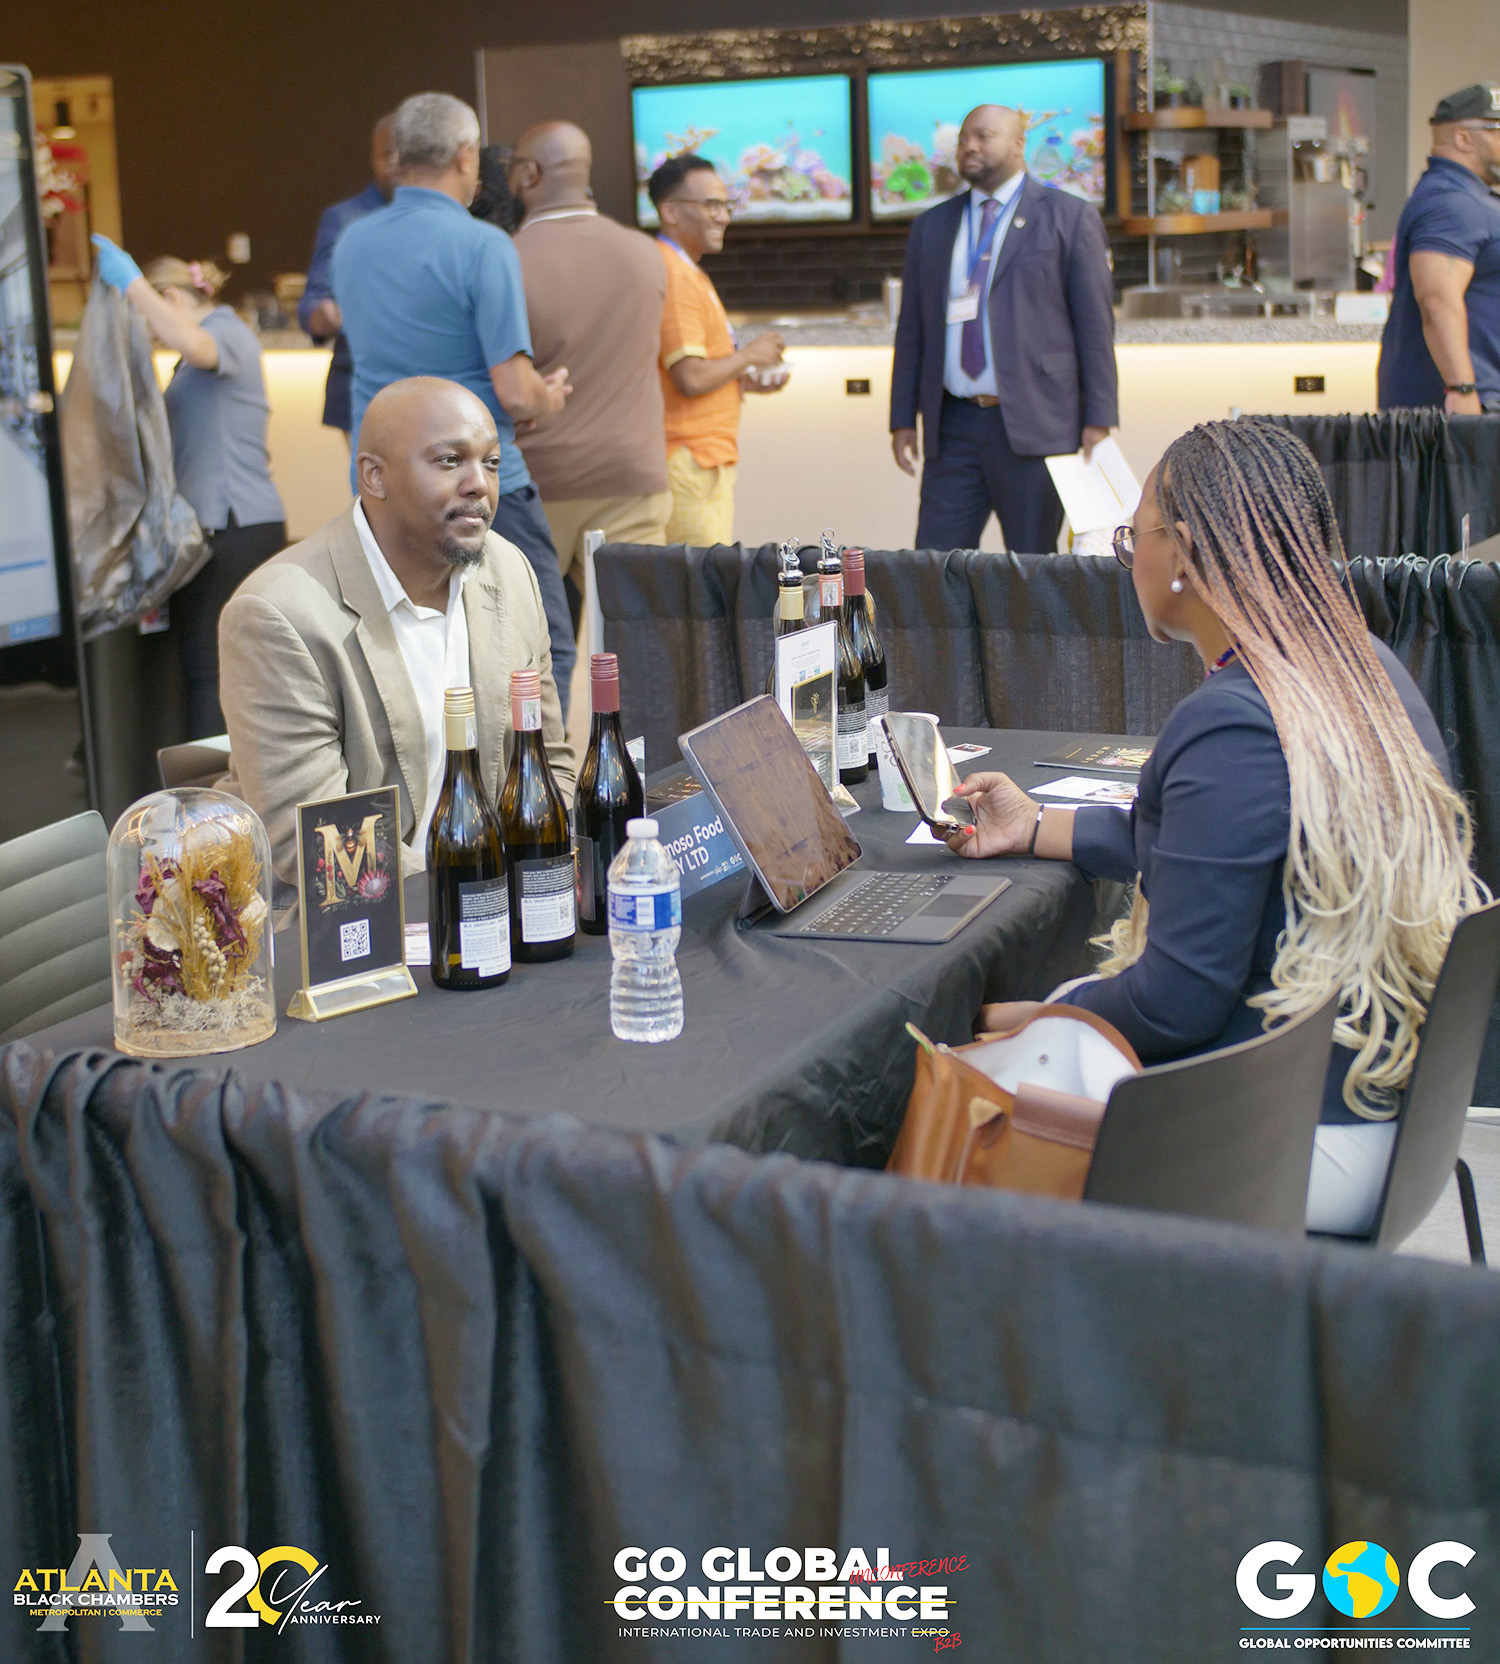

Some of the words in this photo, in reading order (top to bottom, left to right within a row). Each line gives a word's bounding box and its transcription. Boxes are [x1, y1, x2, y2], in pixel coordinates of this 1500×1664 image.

[663, 833, 695, 857] moso
[692, 814, 725, 844] Food
[314, 813, 384, 908] M
[674, 856, 686, 876] Y
[685, 845, 710, 872] LTD
